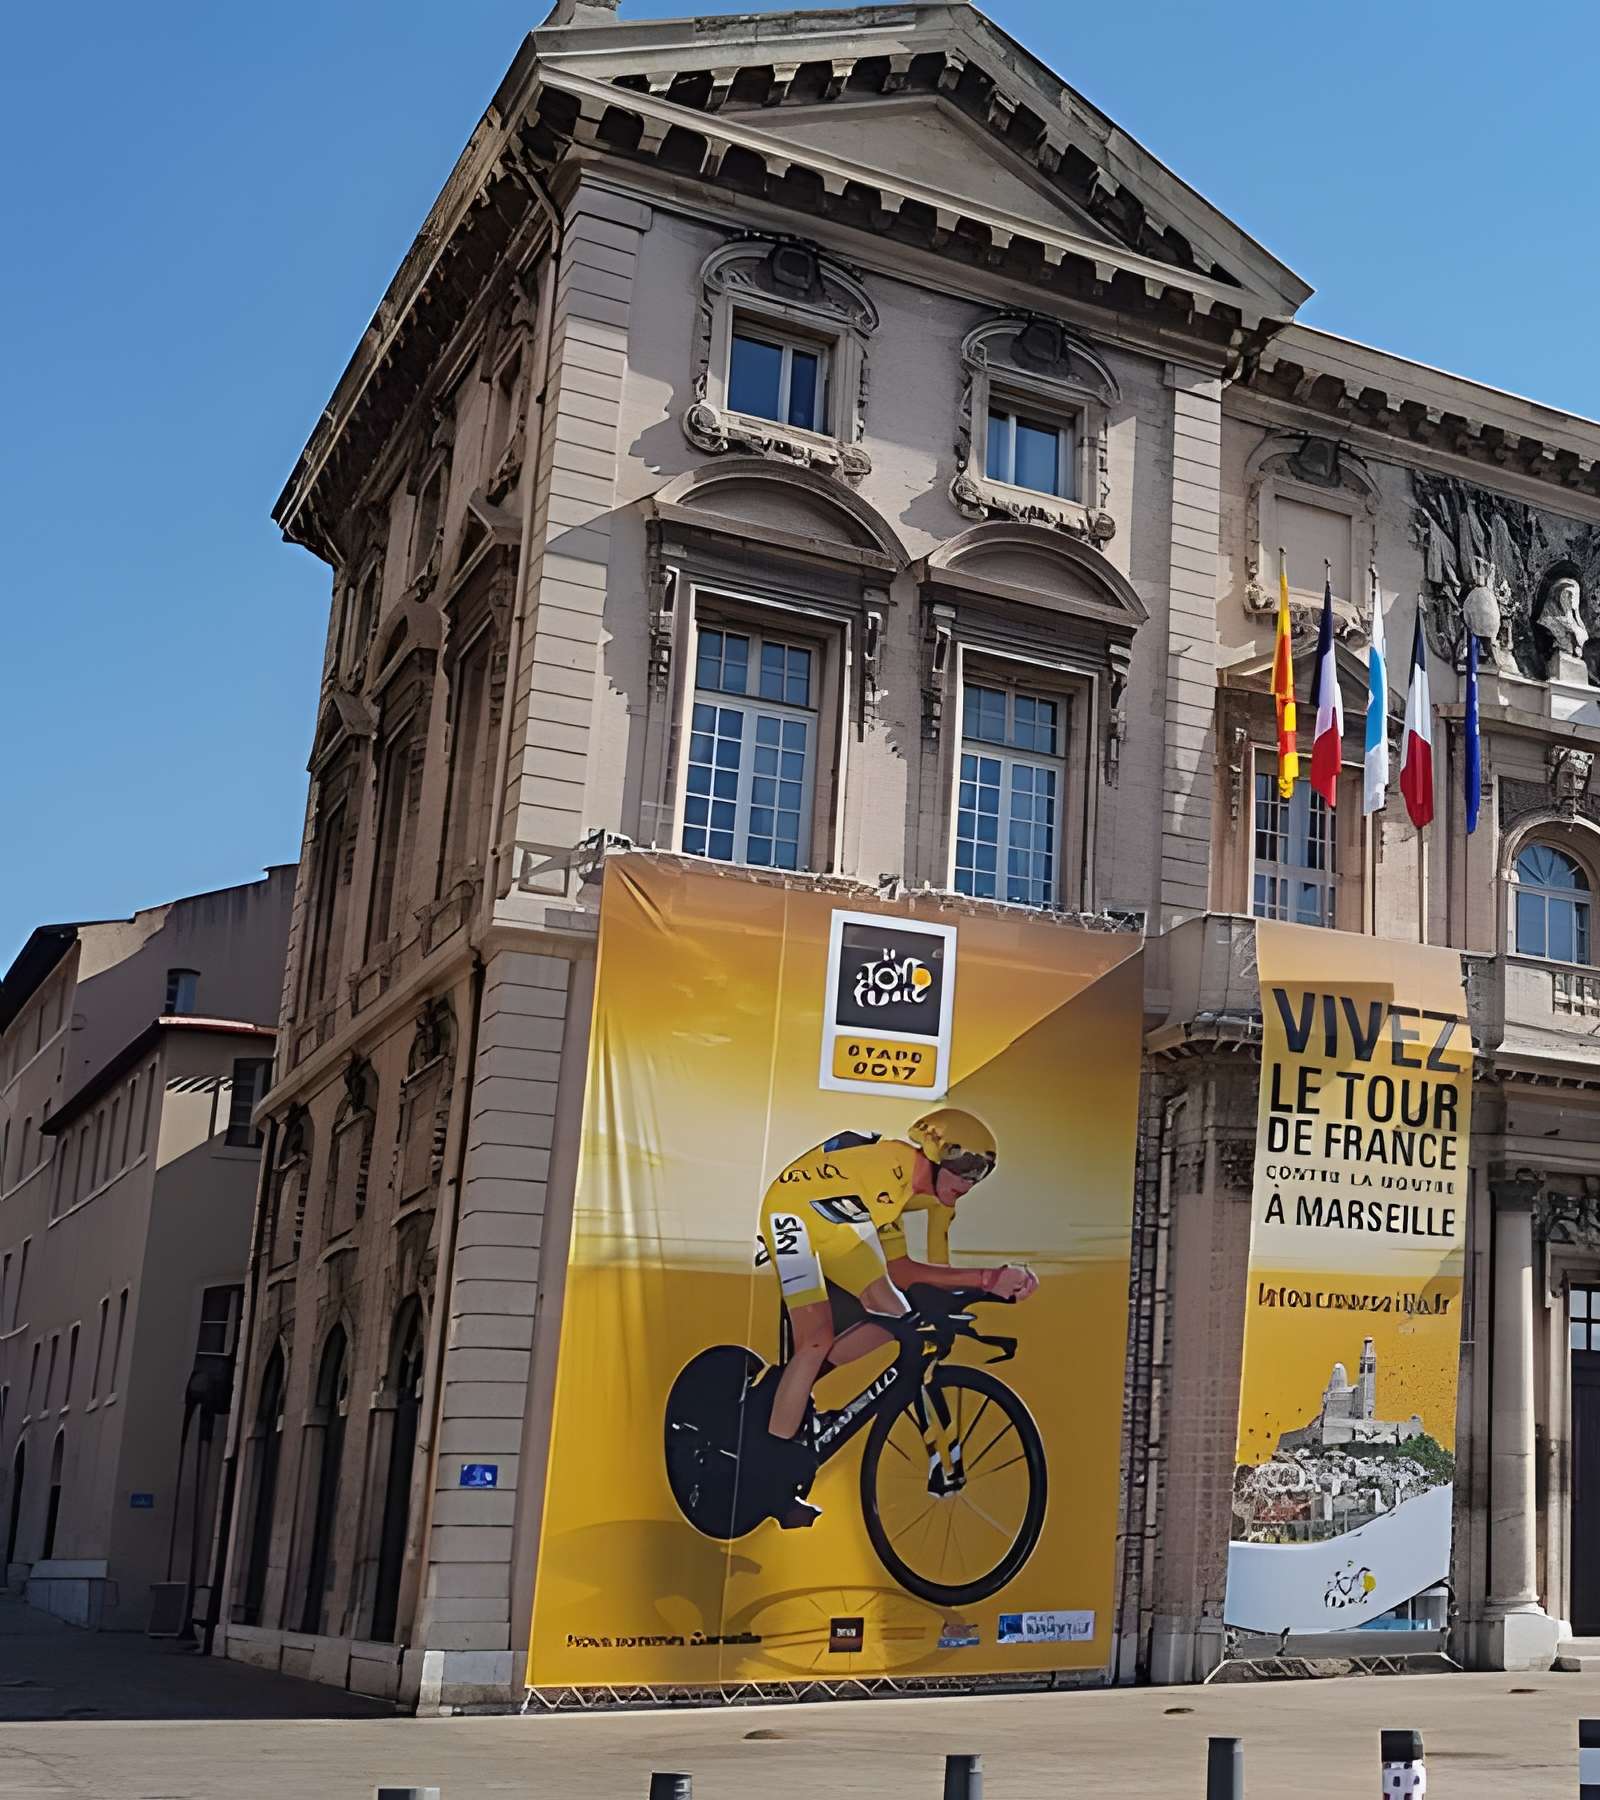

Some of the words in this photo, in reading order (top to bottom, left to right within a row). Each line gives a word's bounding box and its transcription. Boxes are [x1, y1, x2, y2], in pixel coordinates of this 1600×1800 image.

[1272, 988, 1461, 1073] VIVEZ
[1270, 1062, 1323, 1115] LE
[1335, 1071, 1459, 1132] TOUR
[1266, 1116, 1313, 1156] DE
[1324, 1122, 1457, 1171] FRANCE
[1264, 1183, 1286, 1225] À
[1295, 1195, 1456, 1237] MARSEILLE
